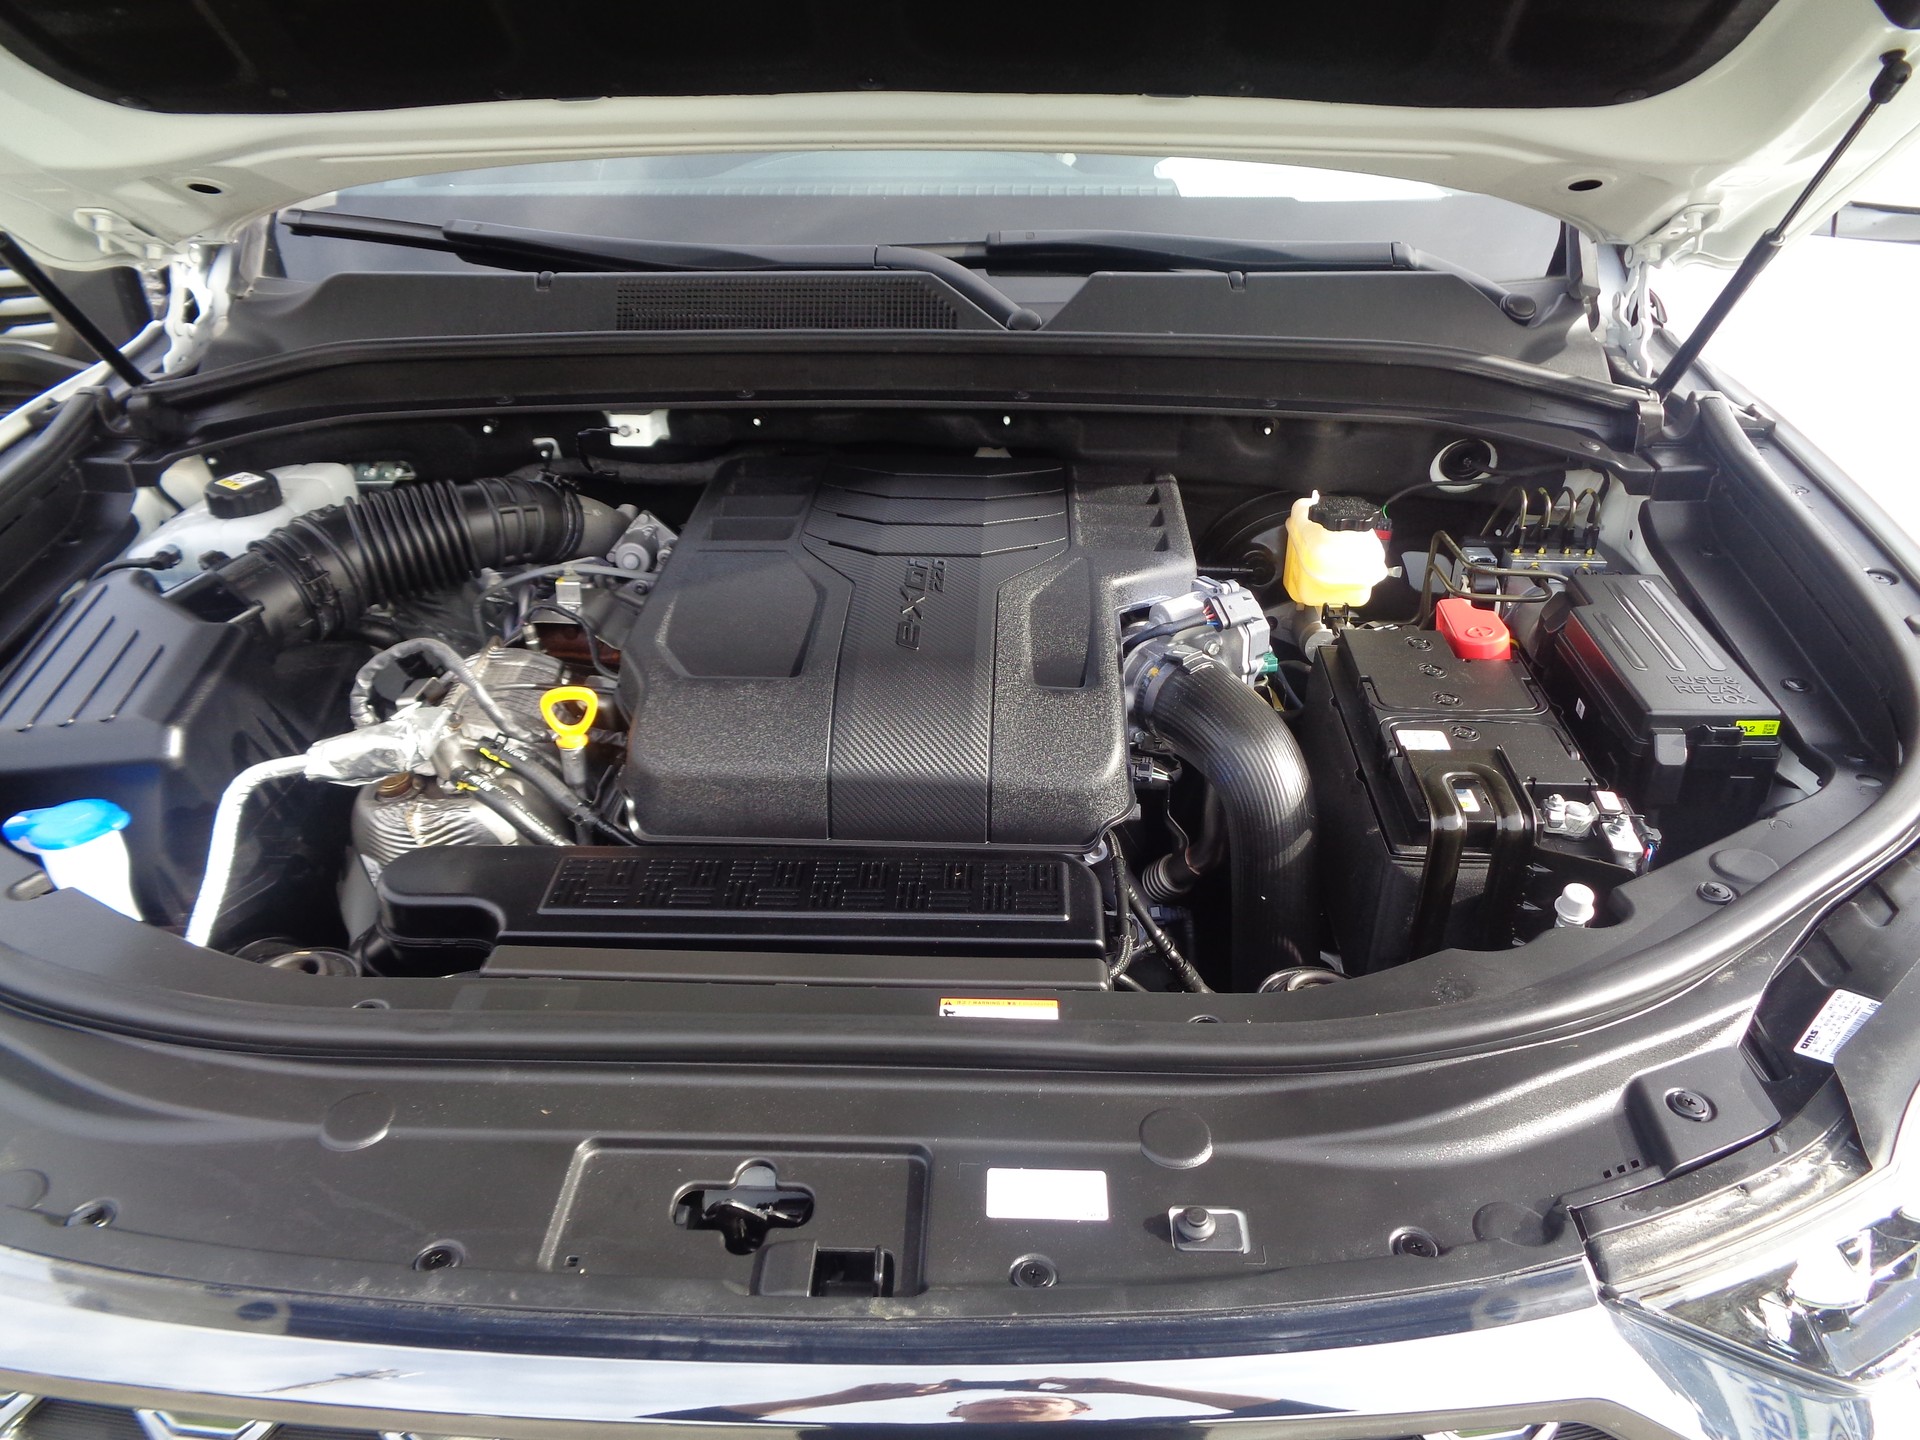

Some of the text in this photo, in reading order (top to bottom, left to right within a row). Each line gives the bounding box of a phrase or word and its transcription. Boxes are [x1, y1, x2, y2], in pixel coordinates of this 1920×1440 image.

[1673, 684, 1745, 694] RELAY
[1707, 694, 1759, 704] BOX
[1800, 1030, 1819, 1050] ams
